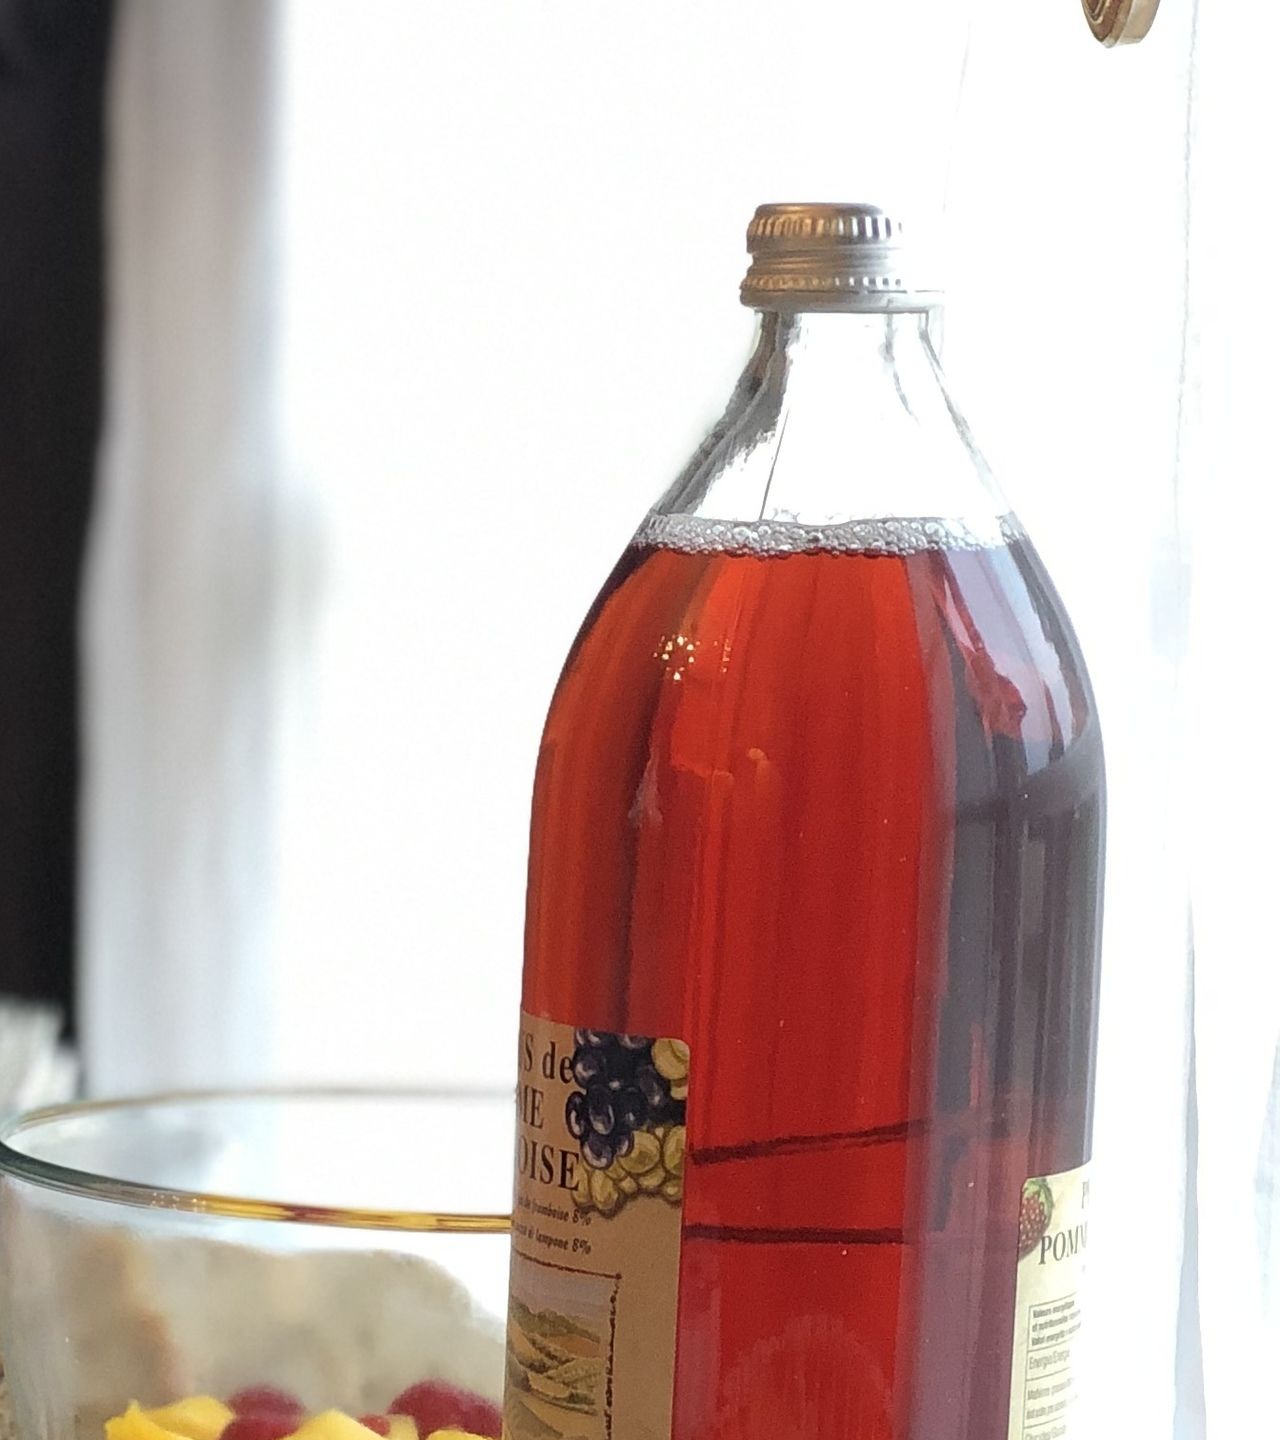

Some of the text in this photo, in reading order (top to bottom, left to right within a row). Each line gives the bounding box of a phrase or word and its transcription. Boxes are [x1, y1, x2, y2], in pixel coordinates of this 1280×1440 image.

[521, 1032, 573, 1085] S de
[571, 1208, 592, 1226] 8%
[571, 1237, 592, 1255] 8%
